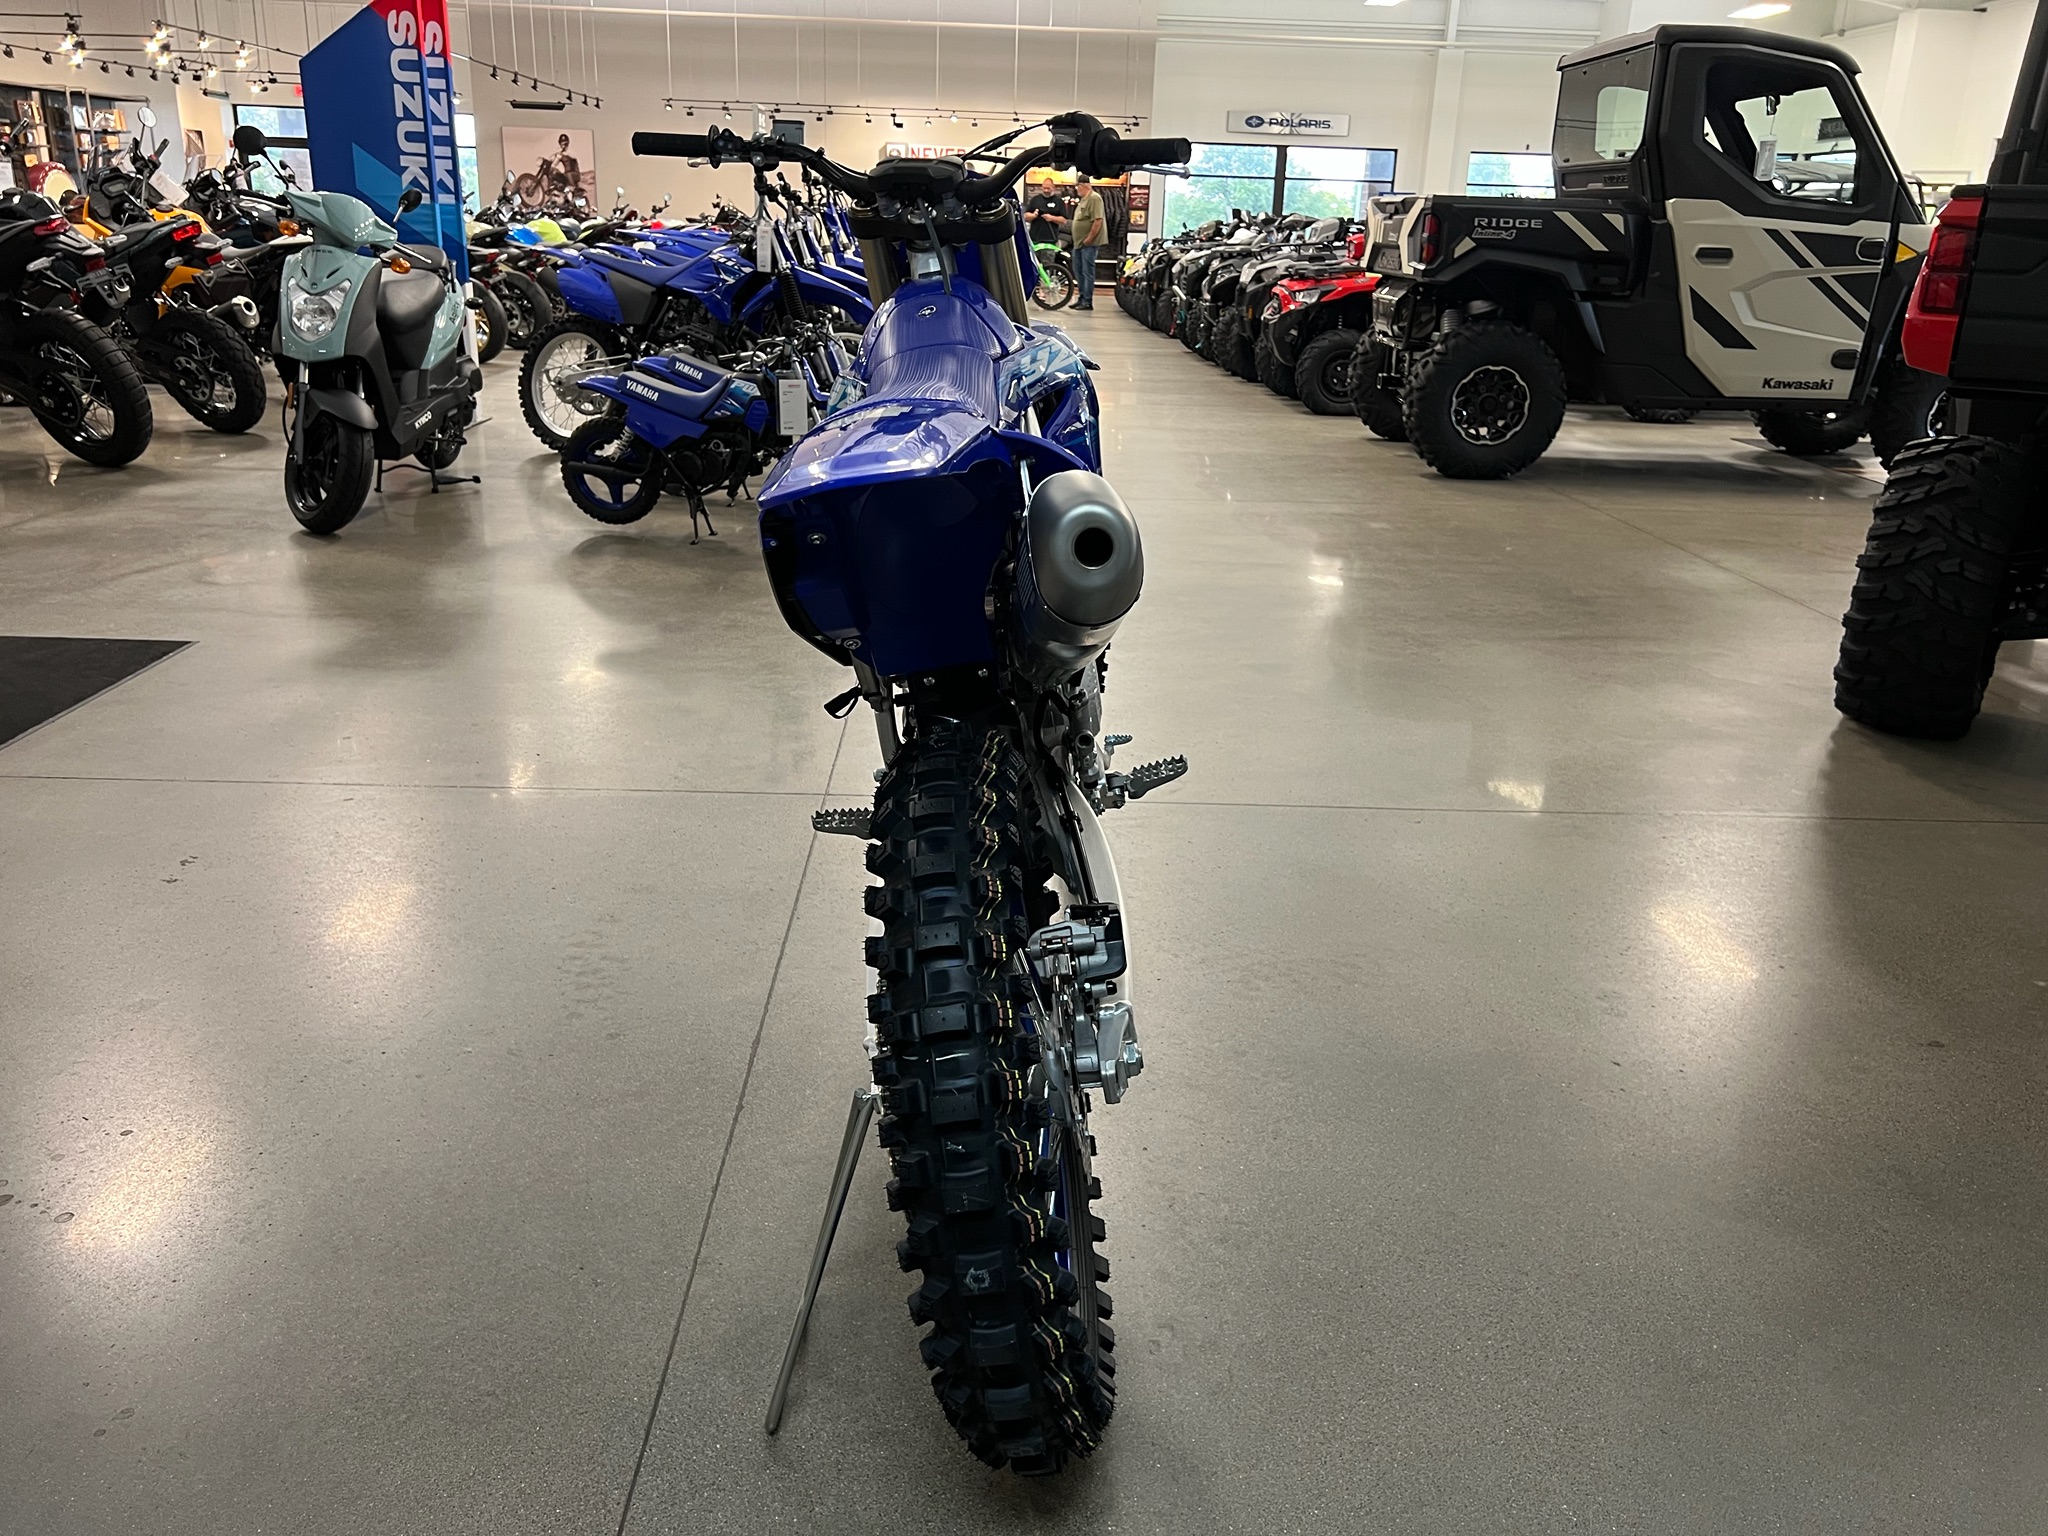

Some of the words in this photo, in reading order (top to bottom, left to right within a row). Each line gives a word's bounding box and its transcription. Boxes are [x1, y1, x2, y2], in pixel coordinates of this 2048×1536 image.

[1269, 118, 1331, 129] POLARIS
[1474, 217, 1543, 228] RIDGE
[674, 361, 703, 381] YAMAHA
[625, 380, 659, 402] YAMAHA
[1762, 377, 1834, 391] Kawasaki
